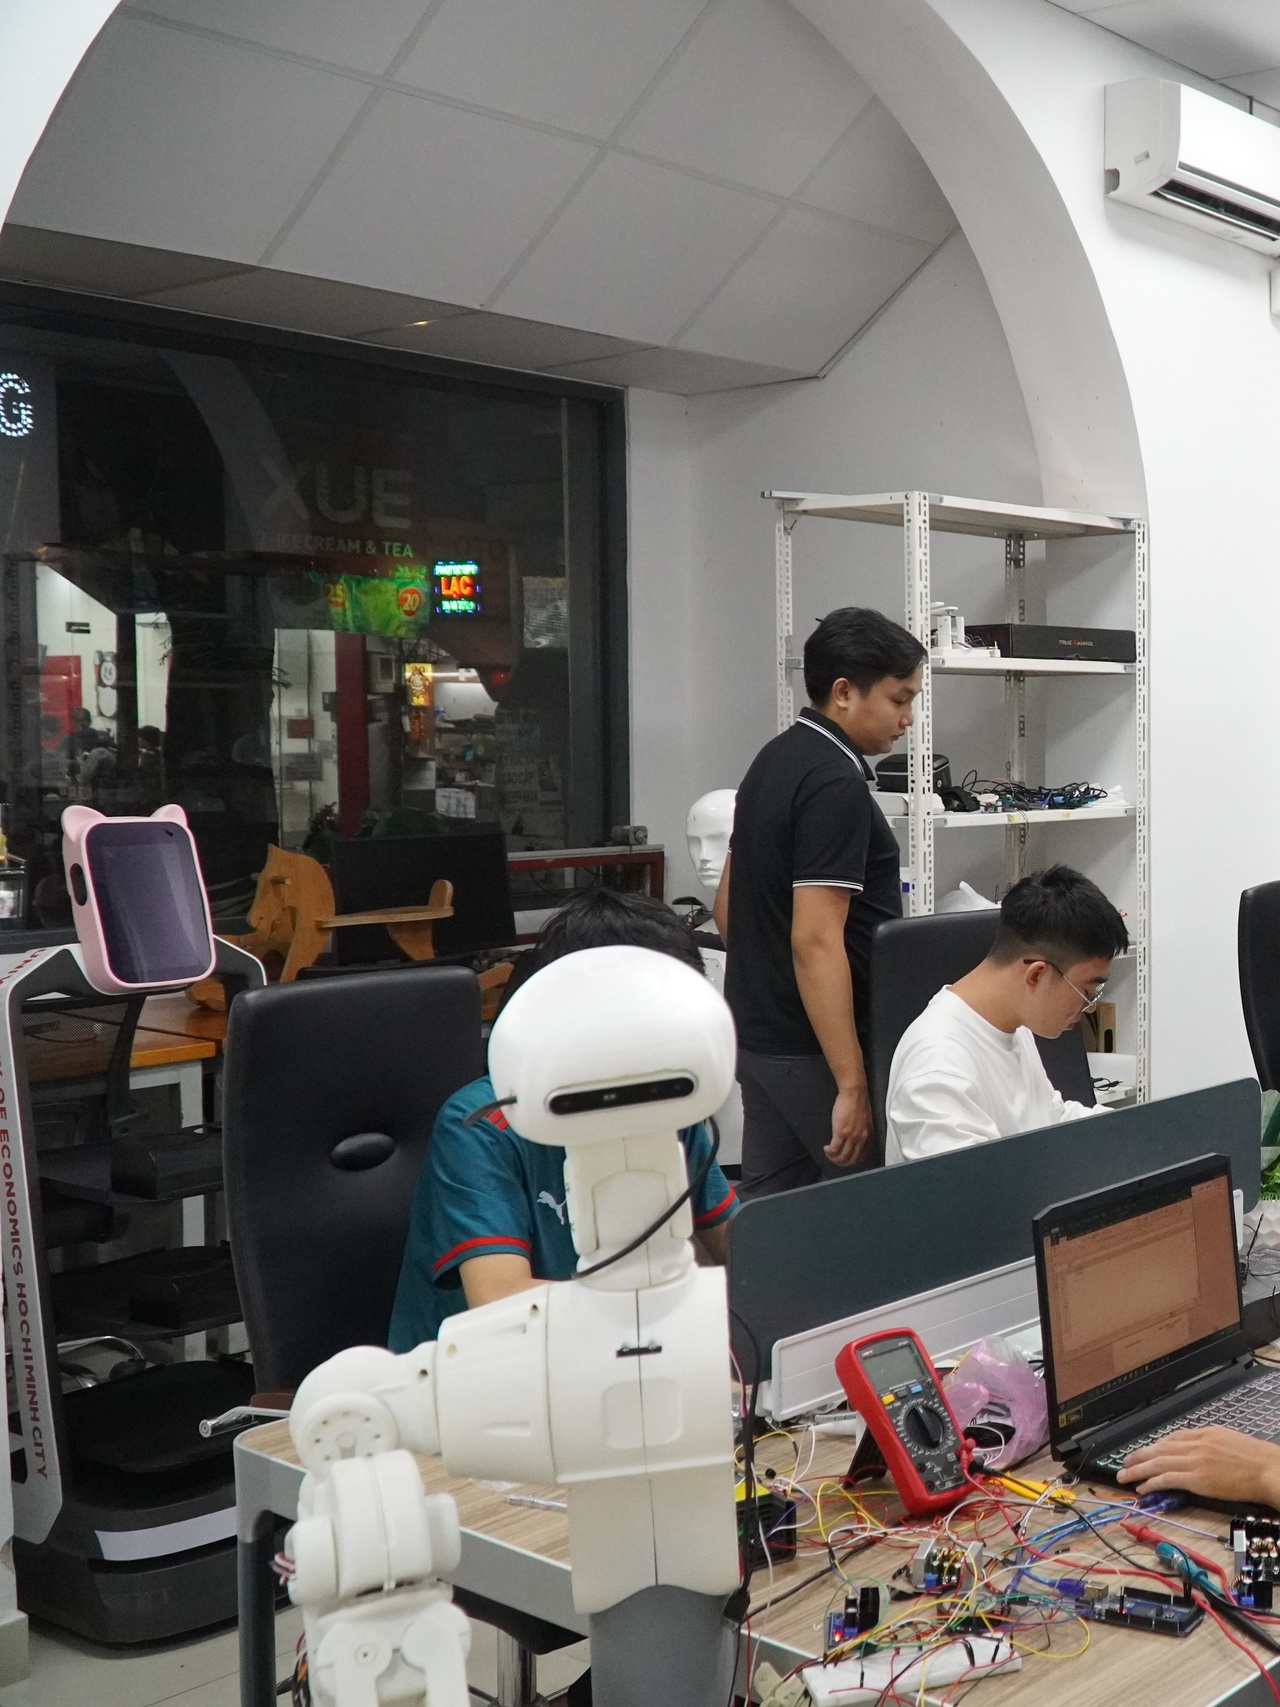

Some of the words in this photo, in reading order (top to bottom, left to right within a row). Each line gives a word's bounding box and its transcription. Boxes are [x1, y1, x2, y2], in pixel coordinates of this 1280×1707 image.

[382, 541, 414, 559] TEA
[402, 593, 420, 611] 20
[32, 1425, 48, 1480] CITY
